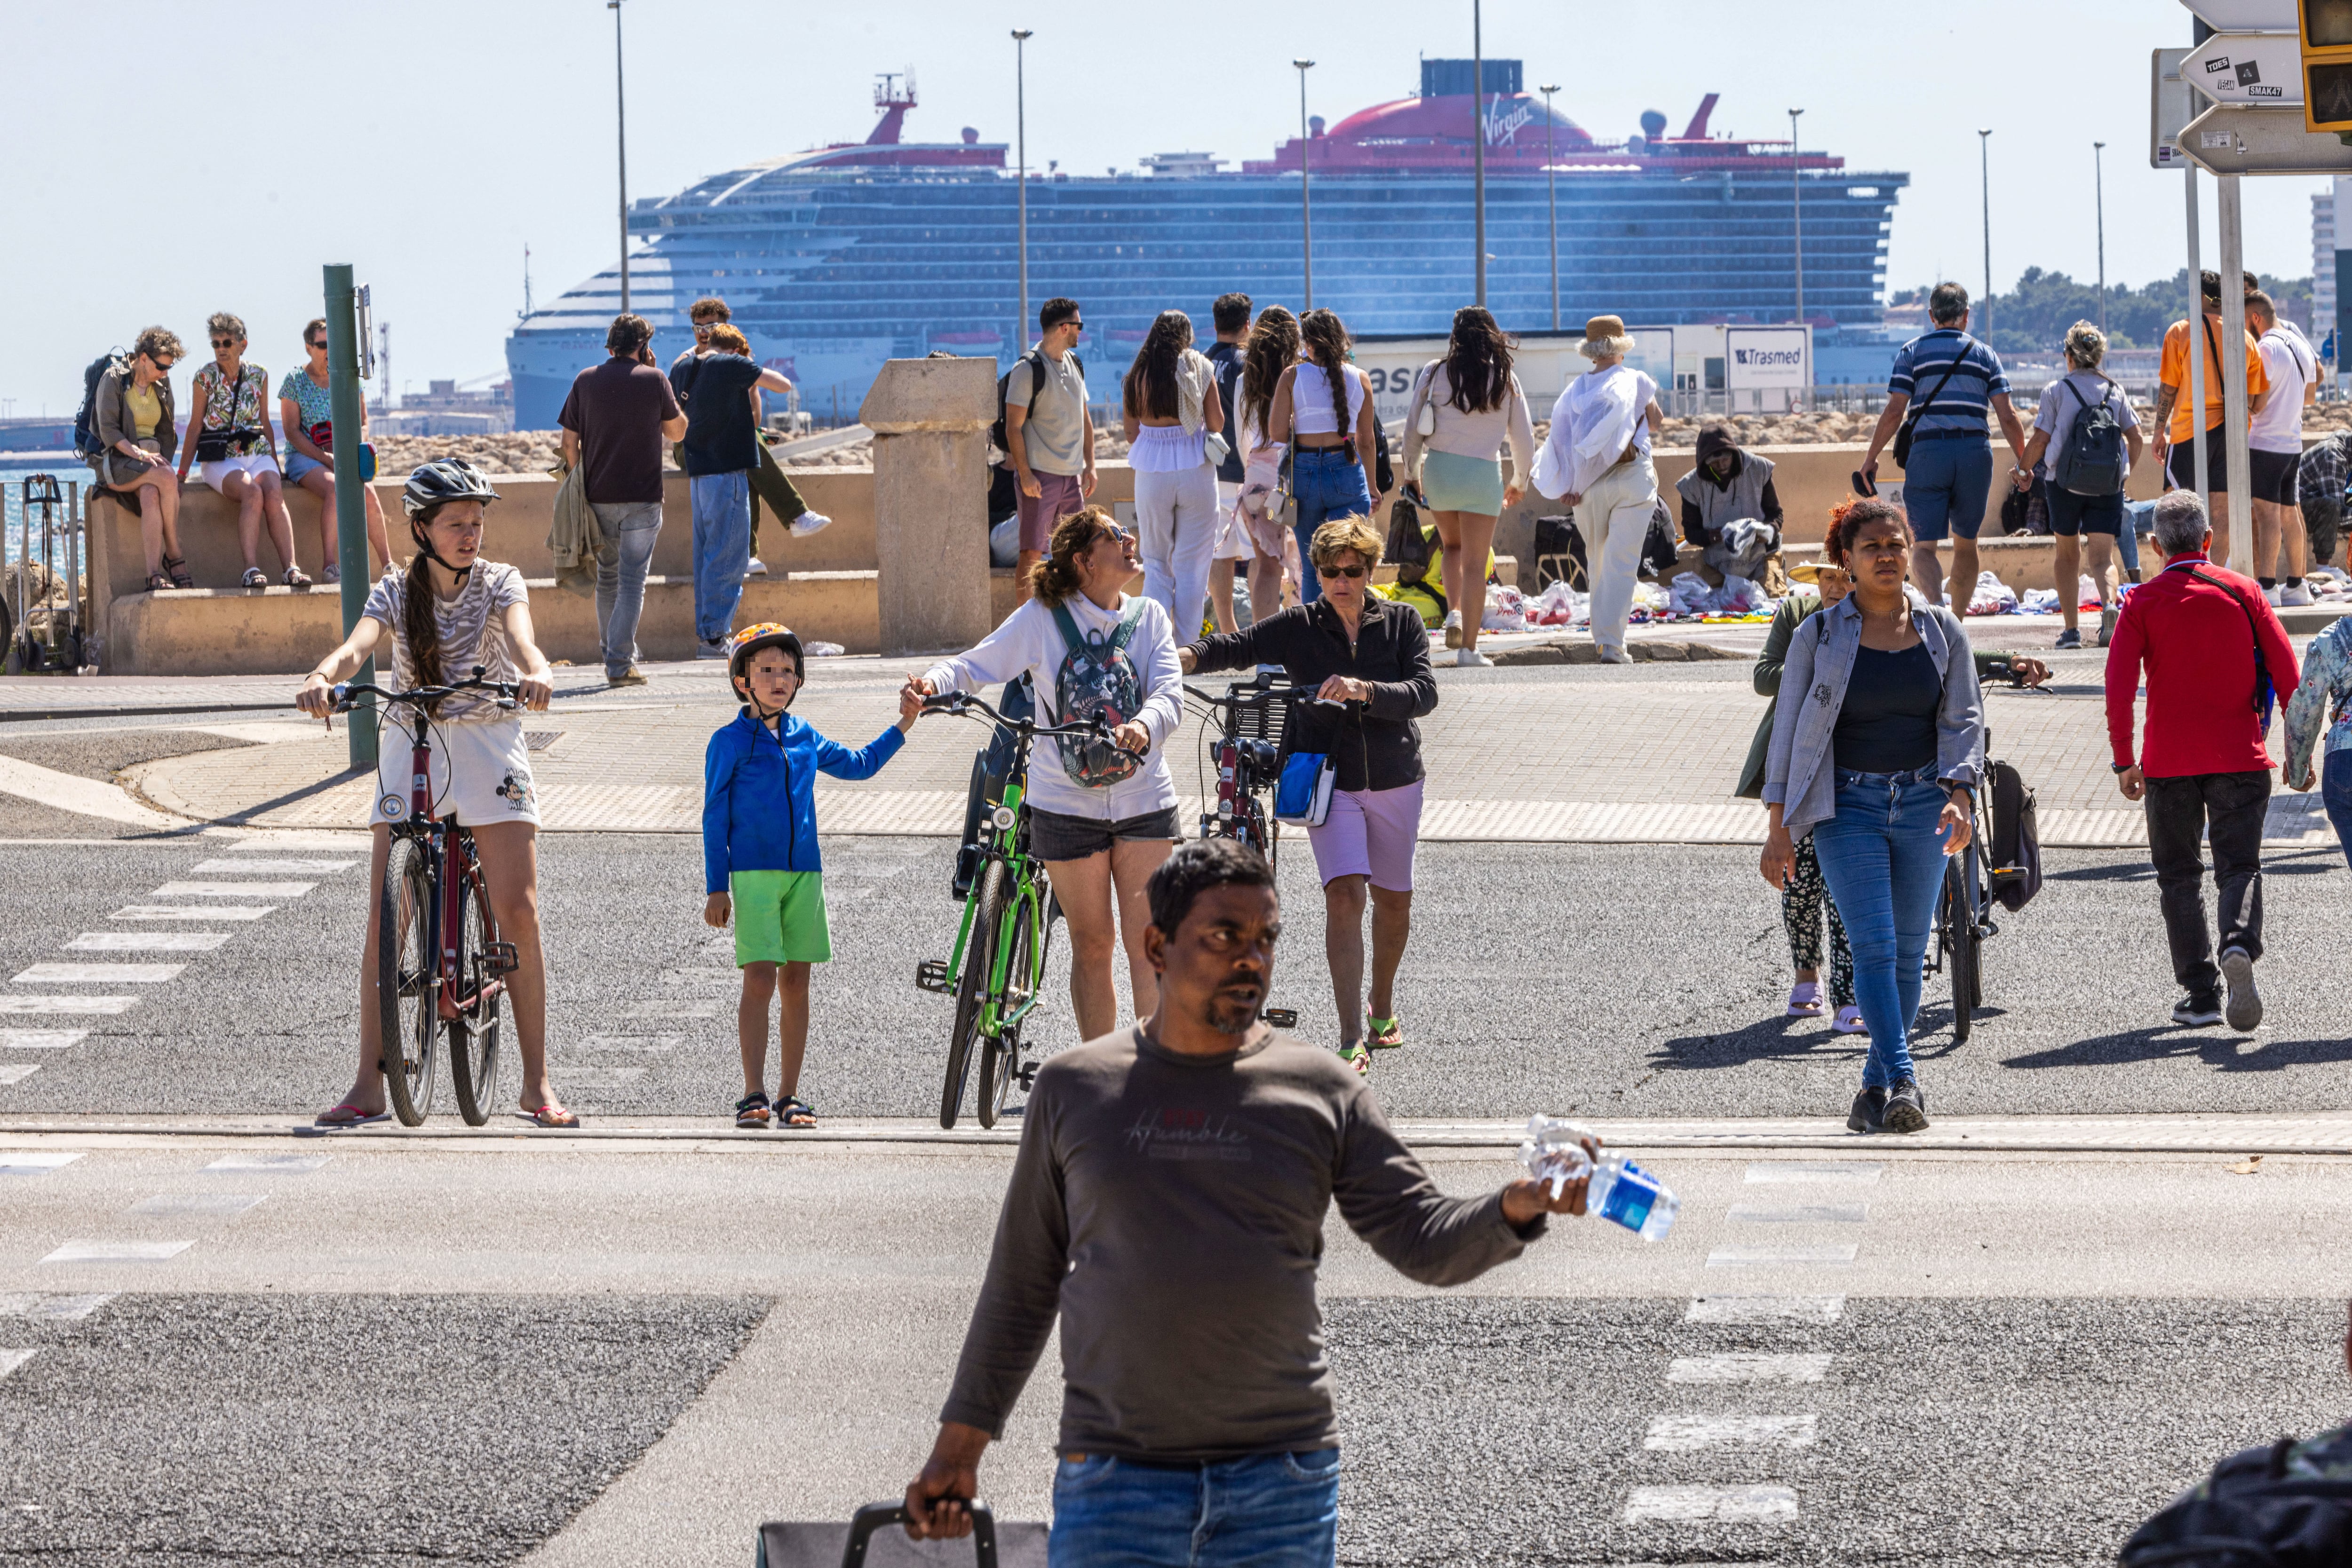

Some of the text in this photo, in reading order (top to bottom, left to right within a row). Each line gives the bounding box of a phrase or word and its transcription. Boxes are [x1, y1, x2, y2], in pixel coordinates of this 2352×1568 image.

[2207, 58, 2228, 72] TOES
[2218, 80, 2234, 90] VEGAN
[2250, 87, 2281, 96] SMAK47
[1482, 92, 1534, 146] Virgin
[1748, 347, 1801, 365] Trasmed
[1497, 592, 1520, 604] Mini
[1123, 1107, 1249, 1152] Humble
